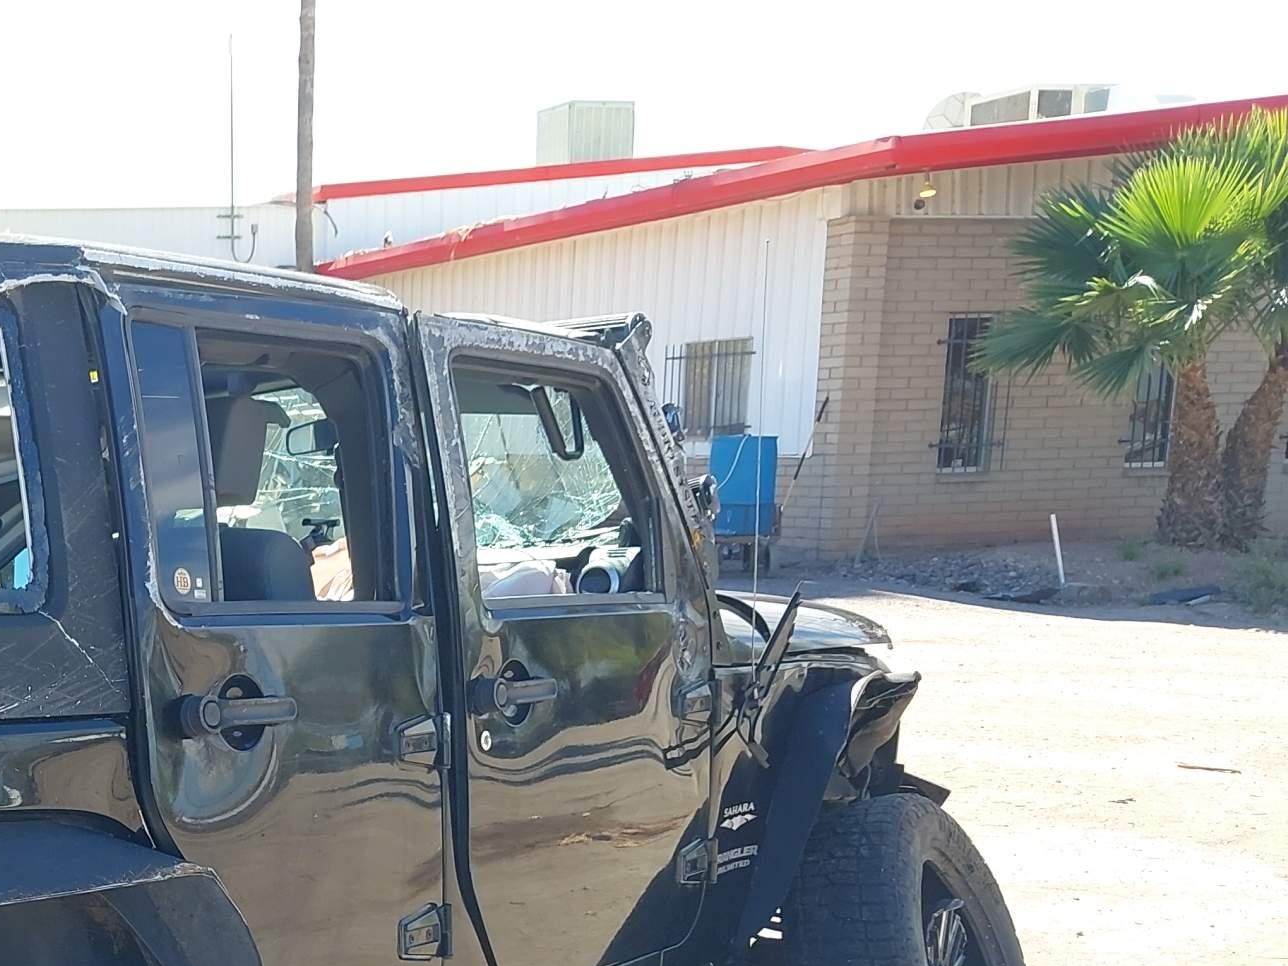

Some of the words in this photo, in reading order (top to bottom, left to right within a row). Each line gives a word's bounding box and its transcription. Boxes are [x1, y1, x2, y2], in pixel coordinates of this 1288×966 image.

[723, 801, 756, 818] SAHARA
[717, 844, 759, 865] RANGLER
[716, 858, 751, 876] NLIMITED
